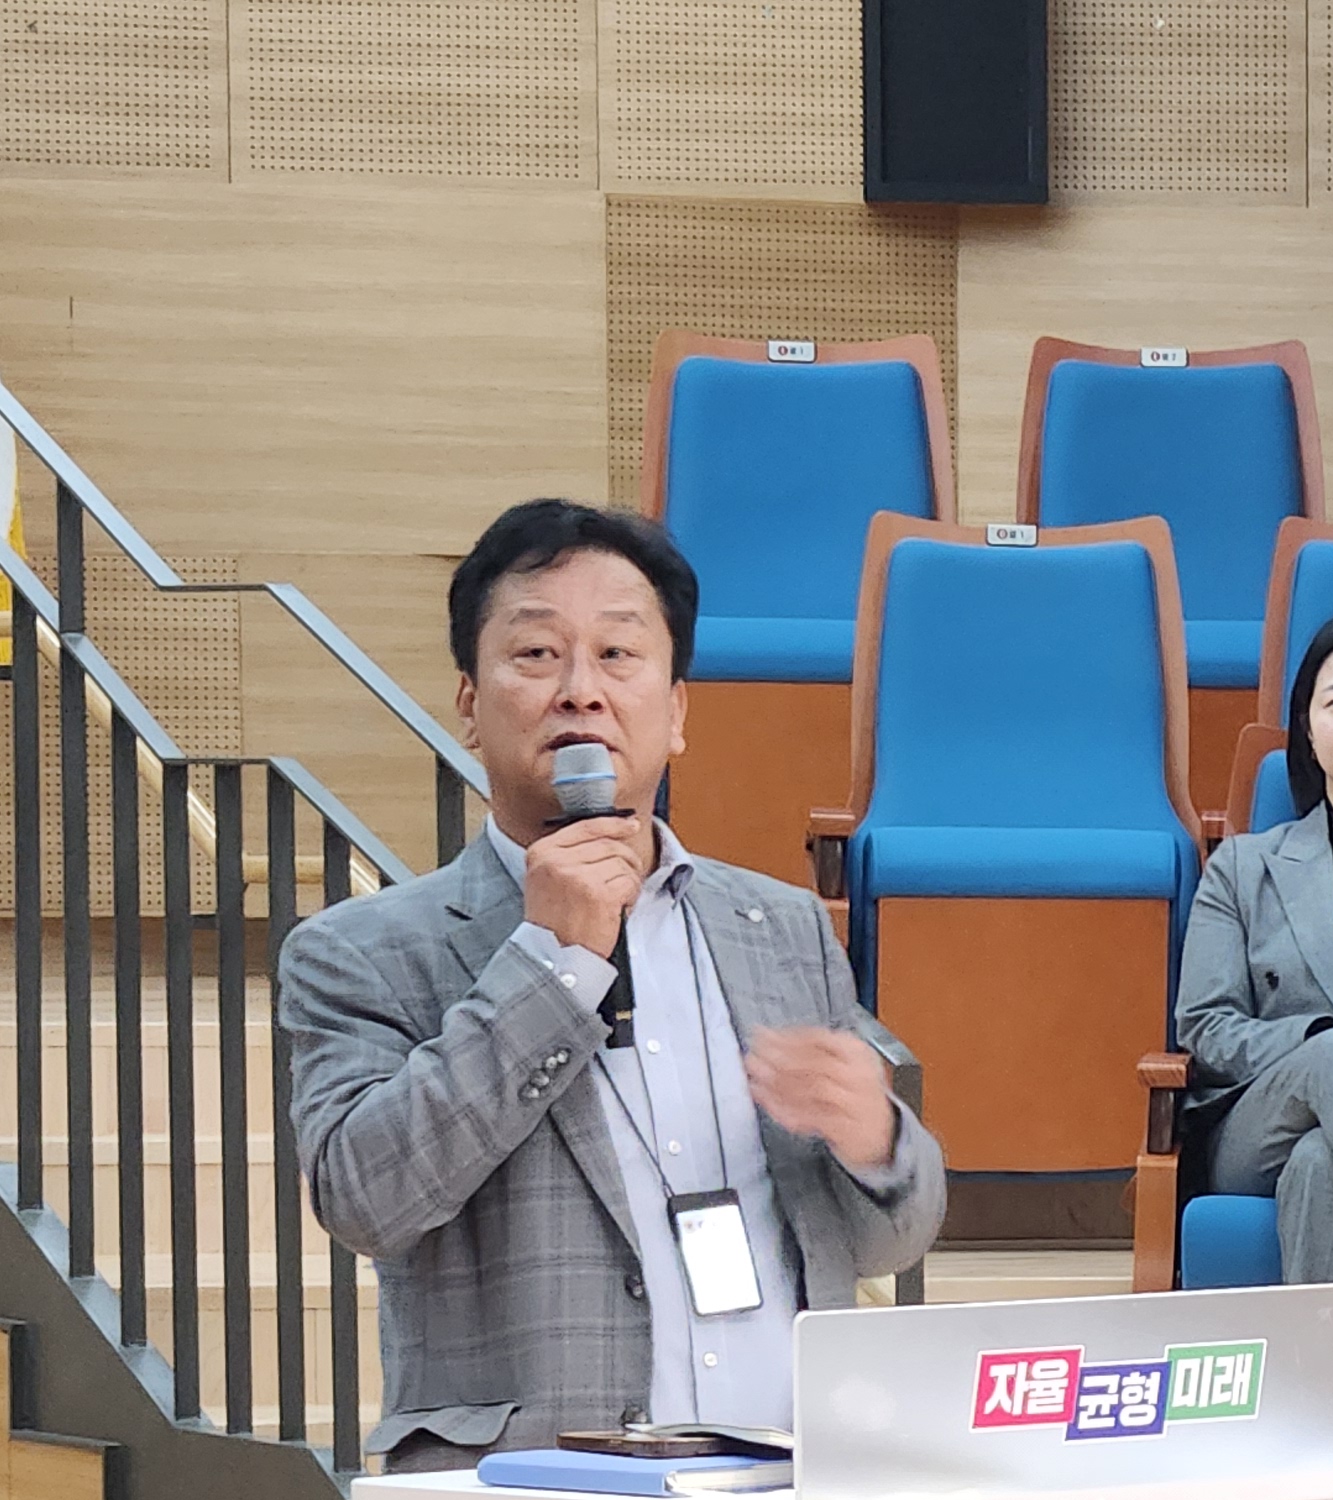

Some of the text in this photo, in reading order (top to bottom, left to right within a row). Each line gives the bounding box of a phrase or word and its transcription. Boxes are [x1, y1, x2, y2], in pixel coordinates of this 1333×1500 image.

[984, 1352, 1254, 1429] 자율 균형 미래
